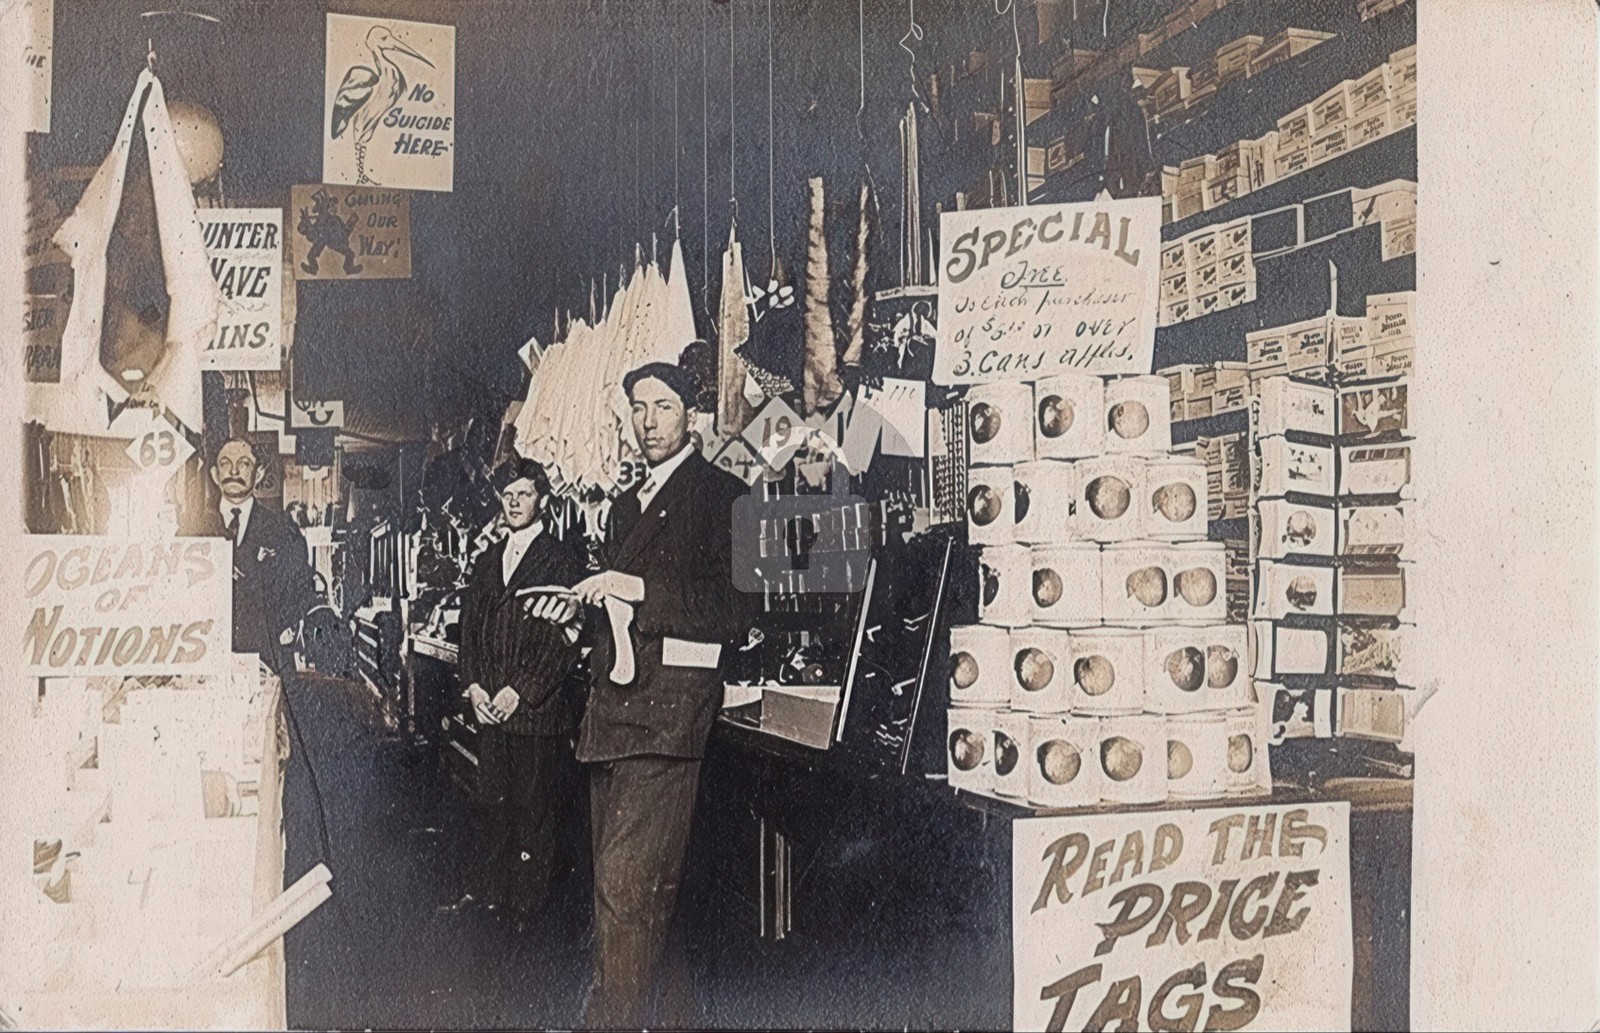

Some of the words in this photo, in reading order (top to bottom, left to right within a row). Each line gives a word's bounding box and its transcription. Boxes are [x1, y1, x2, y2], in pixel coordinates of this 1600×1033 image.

[408, 83, 435, 103] No
[383, 107, 453, 131] SUICIDE
[200, 222, 278, 249] UNTER
[366, 212, 398, 229] OUR
[358, 234, 401, 259] WAY!
[946, 211, 1141, 284] SPECIAL
[1075, 317, 1136, 337] over
[761, 415, 792, 448] 19
[139, 430, 177, 467] 63
[23, 541, 216, 599] OCEANS
[94, 584, 152, 613] OF
[22, 604, 215, 668] NOTIONS
[1030, 822, 1184, 916] READ
[1206, 808, 1328, 867] THE
[1093, 868, 1321, 958] PRICE
[1040, 953, 1265, 1032] TAGS
